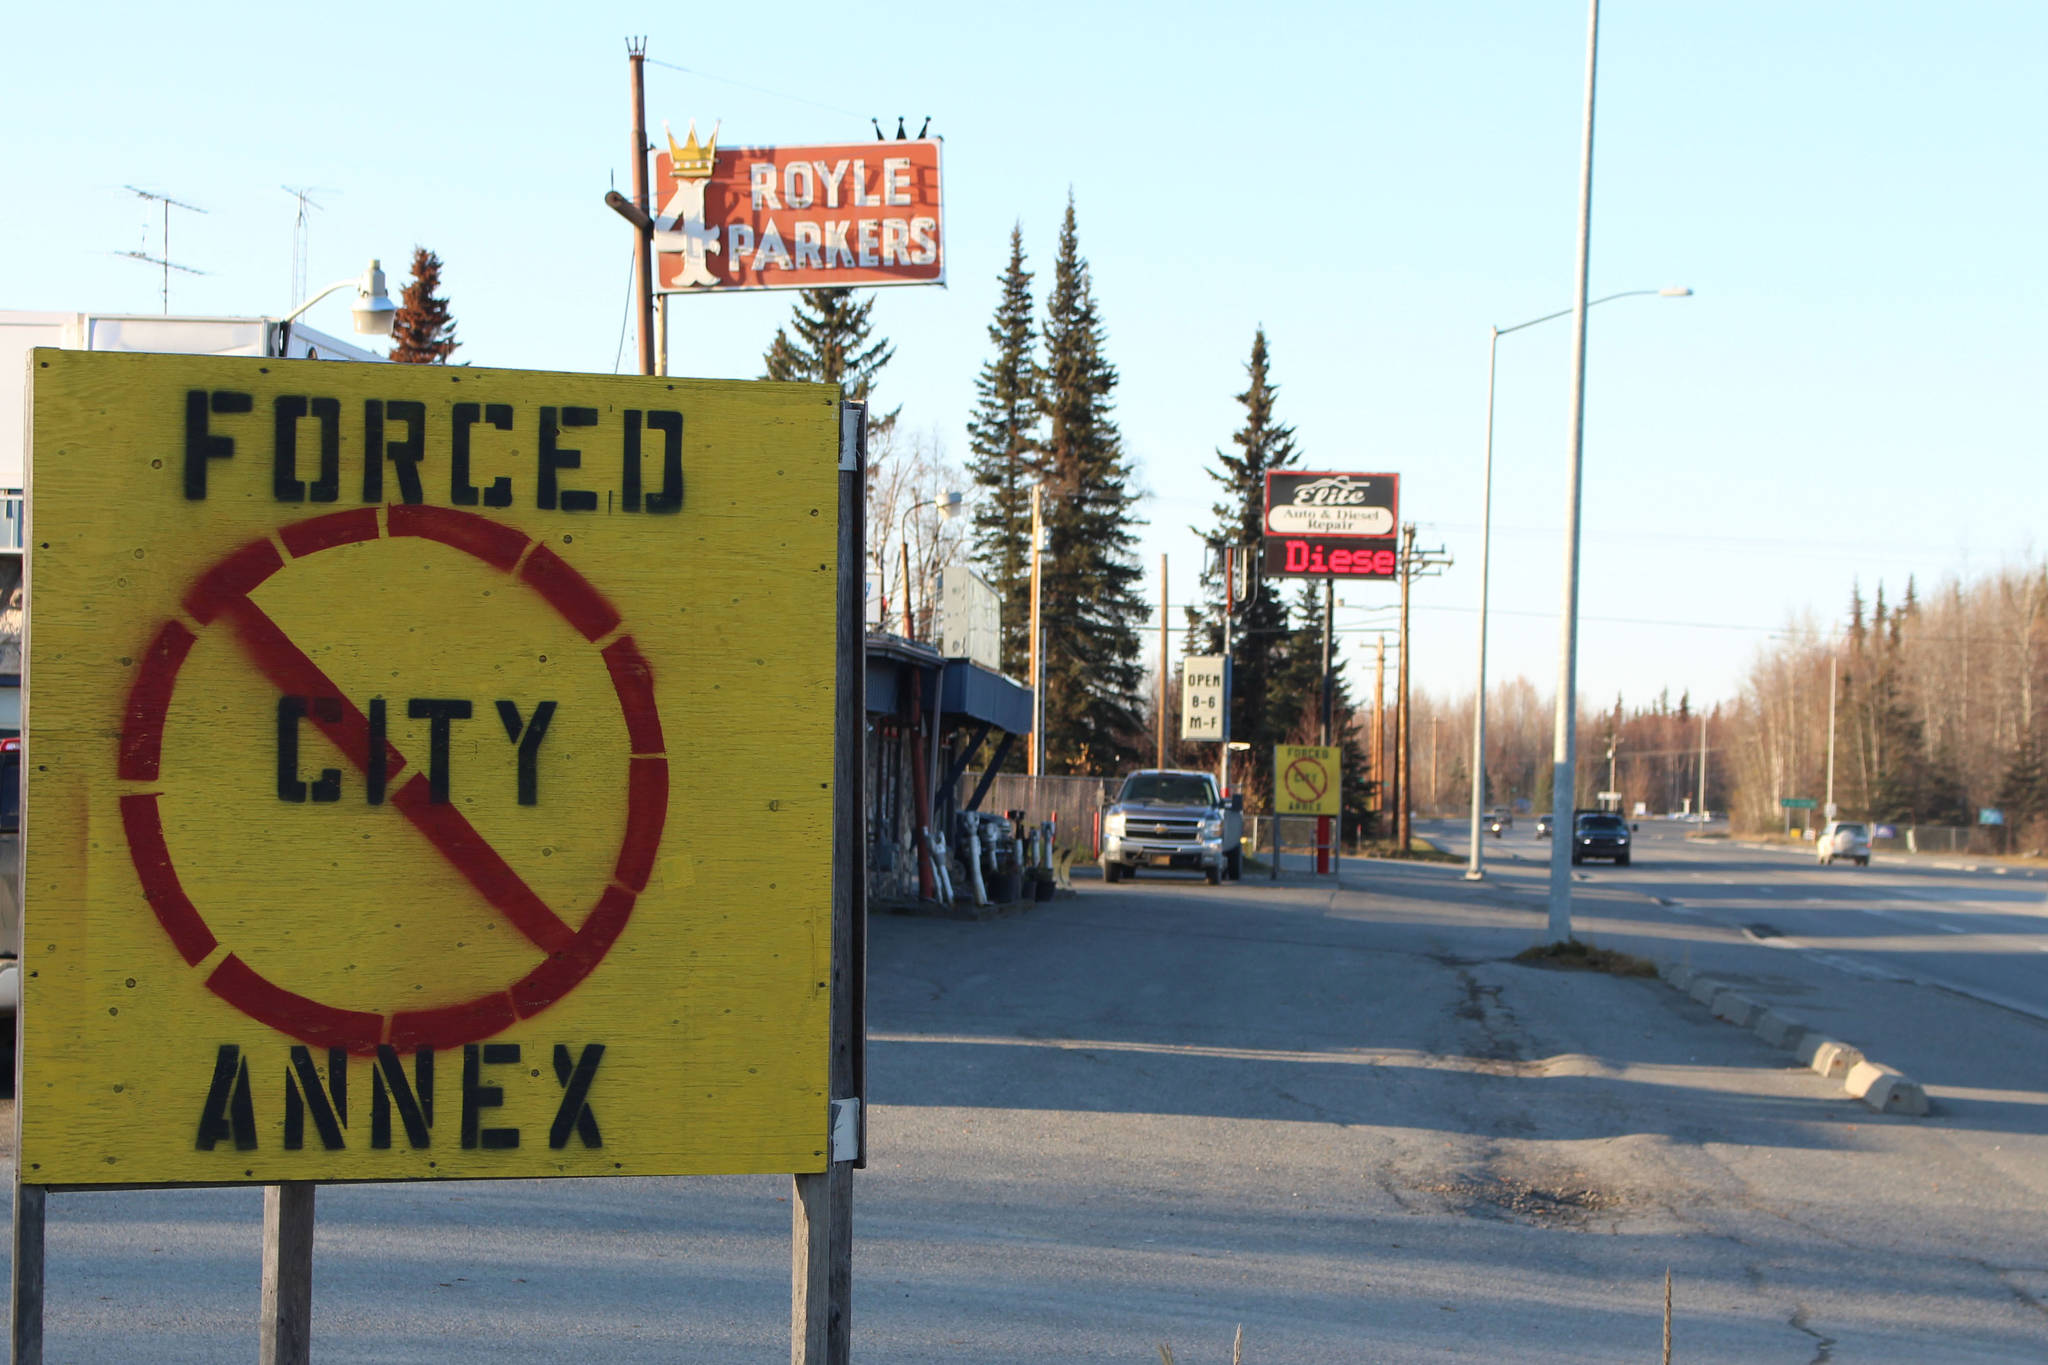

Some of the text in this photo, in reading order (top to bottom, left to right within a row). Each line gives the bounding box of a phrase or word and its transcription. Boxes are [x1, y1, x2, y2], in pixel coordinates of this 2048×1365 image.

[751, 158, 912, 211] ROYLE
[653, 178, 721, 287] 4
[728, 216, 937, 272] PARKERS
[183, 389, 685, 515] FORCED
[1283, 509, 1380, 521] Auto & Diesel
[1293, 486, 1366, 507] Elite
[1308, 519, 1355, 533] Repair
[1285, 540, 1396, 575] Diese
[276, 695, 558, 807] CITY
[195, 1043, 607, 1152] ANNEX
